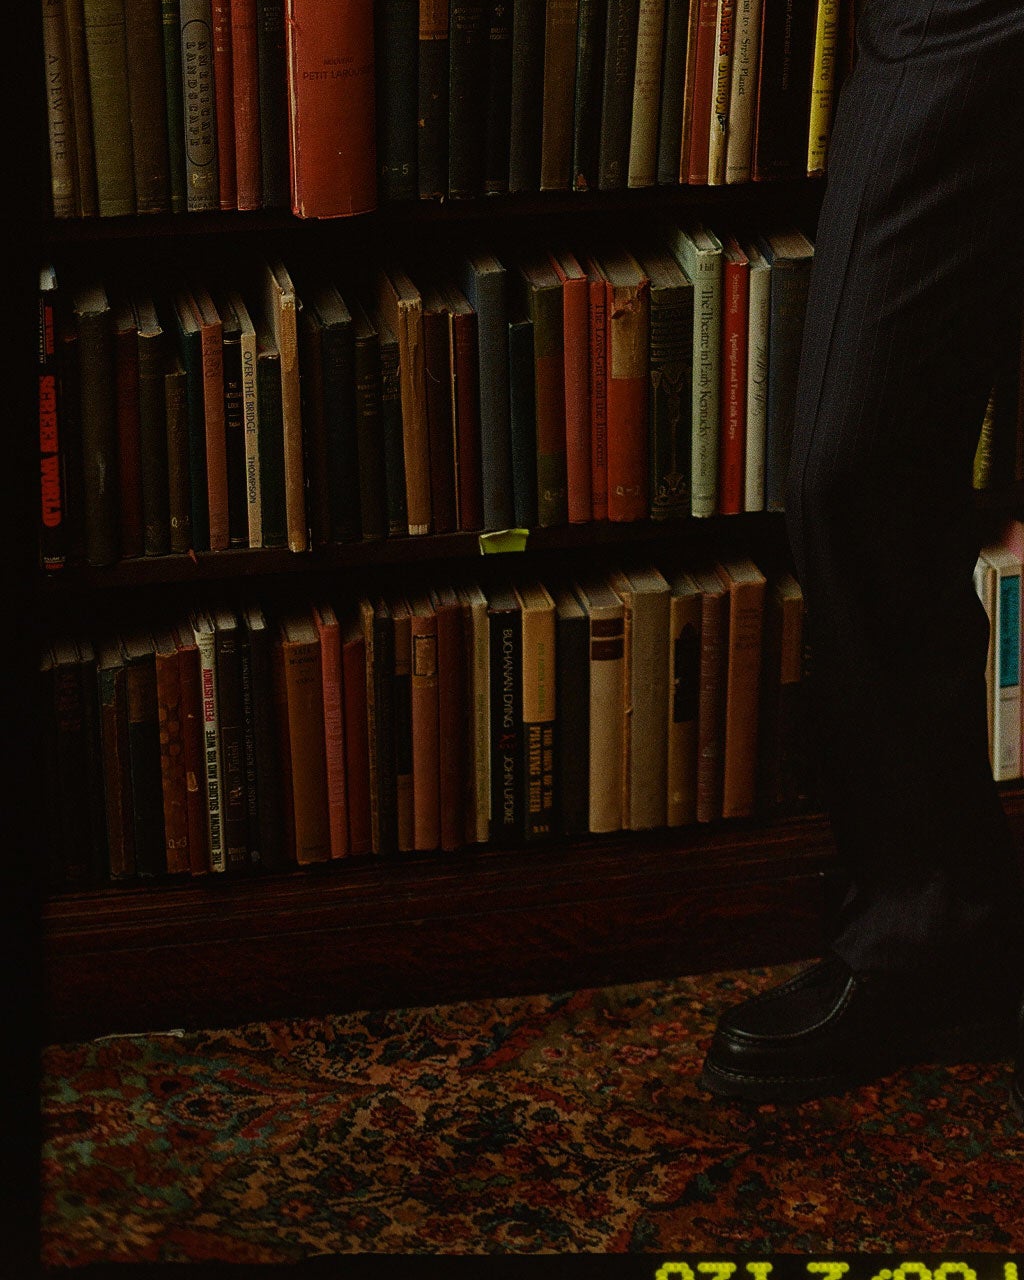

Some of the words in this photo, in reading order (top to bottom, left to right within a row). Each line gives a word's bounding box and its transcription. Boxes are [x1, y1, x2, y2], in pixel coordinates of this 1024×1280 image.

[742, 17, 751, 28] to
[823, 20, 835, 40] All
[740, 38, 751, 64] Small
[820, 46, 834, 82] Here
[303, 69, 328, 81] PETIT
[738, 68, 749, 97] Planet
[50, 71, 63, 111] NEW
[186, 41, 199, 147] LANDSCAPE
[198, 41, 211, 145] AMERICAN
[53, 119, 65, 161] LIFE
[700, 290, 714, 310] The
[700, 310, 714, 347] Theatre
[244, 351, 253, 378] OVER
[701, 350, 712, 360] in
[245, 380, 255, 399] THE
[698, 362, 712, 388] Early
[246, 401, 256, 435] BRIDGE
[698, 390, 712, 438] Kentucky
[247, 456, 258, 505] THOMPSON
[503, 628, 514, 691] BUCHANAN
[203, 668, 214, 700] USTINOV
[204, 699, 216, 723] PETER
[502, 693, 514, 729] DYING
[205, 730, 216, 749] WIFE
[206, 749, 217, 763] HIS
[503, 755, 514, 786] JOHN
[207, 764, 218, 780] AND
[209, 780, 220, 812] SOLDIER
[503, 787, 514, 825] UPDIKE
[210, 813, 221, 851] UNKNOWN
[211, 851, 222, 866] THE
